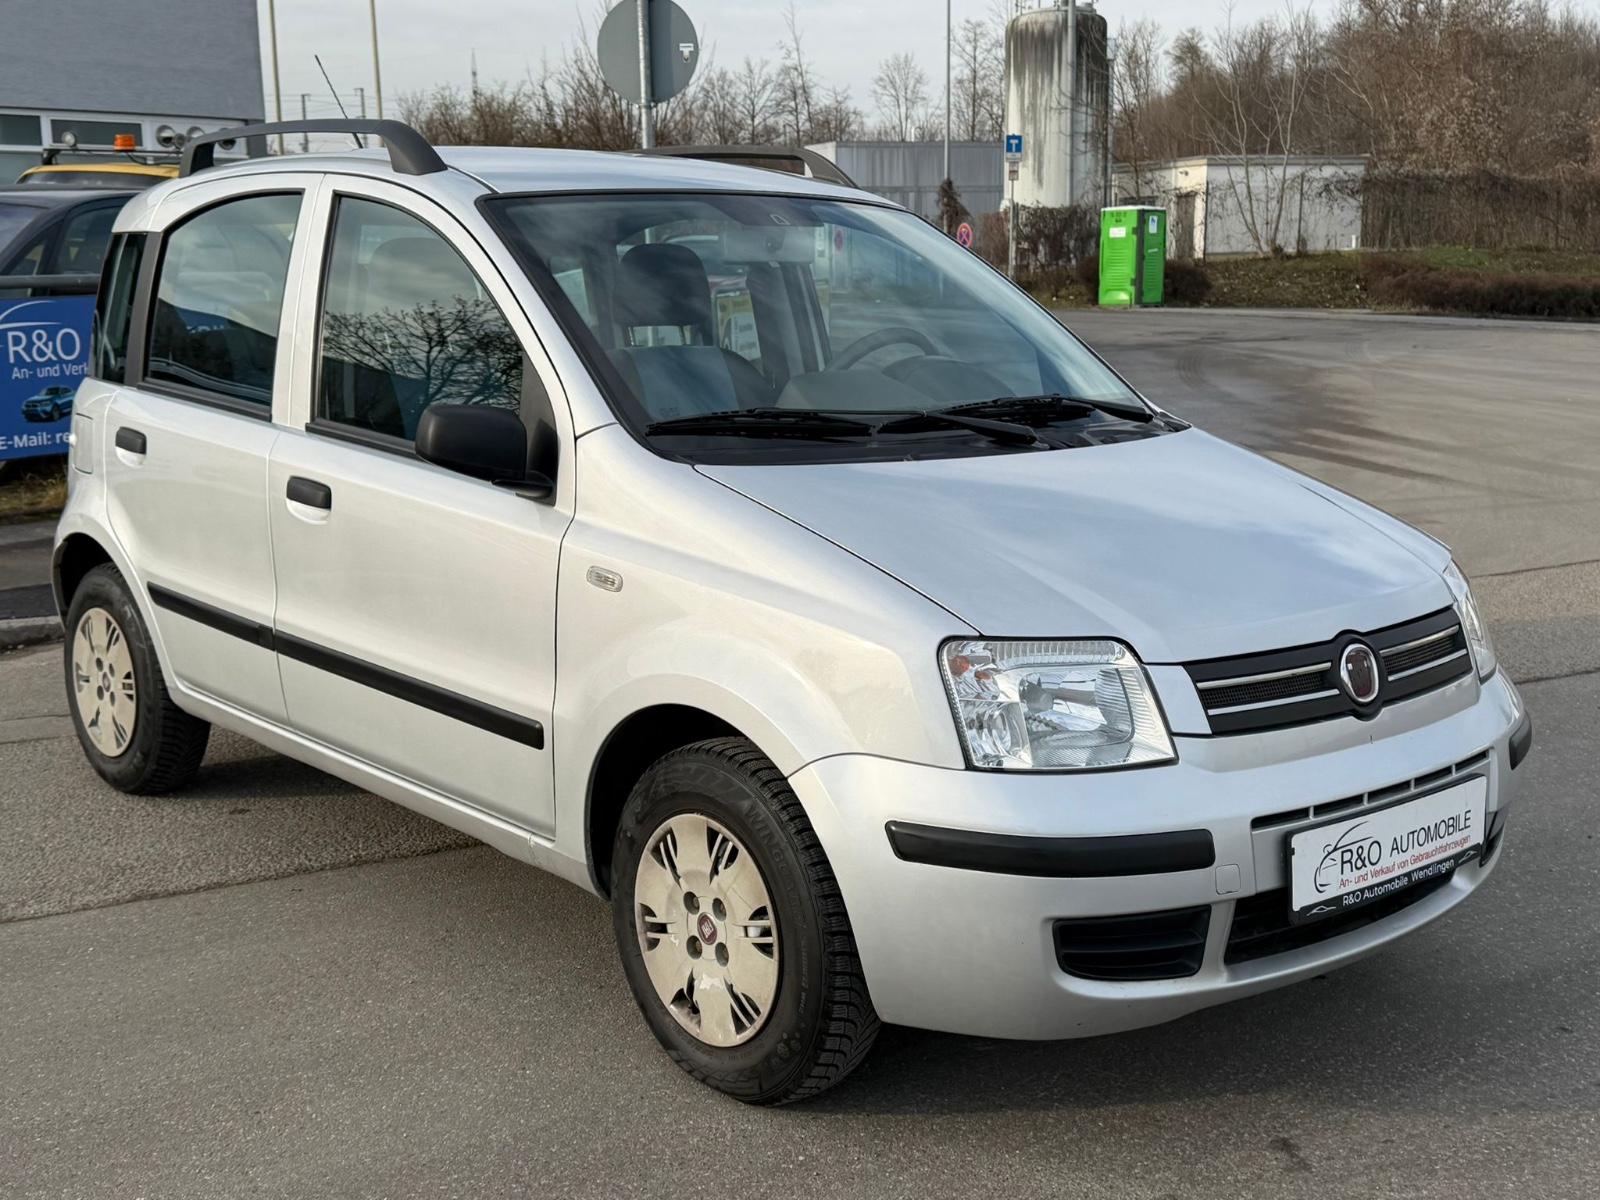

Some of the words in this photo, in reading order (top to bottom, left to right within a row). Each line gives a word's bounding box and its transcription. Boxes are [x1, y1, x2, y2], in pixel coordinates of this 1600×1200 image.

[7, 328, 81, 364] R&O
[12, 367, 33, 380] An-
[37, 364, 60, 377] und
[0, 432, 51, 450] E-Mail:
[1340, 840, 1382, 875] R&O
[1390, 810, 1471, 858] AUTOMOBILE
[1339, 878, 1353, 889] An-
[1354, 872, 1368, 884] und
[1370, 863, 1396, 880] Verkauf
[1397, 859, 1409, 870] von
[1342, 891, 1362, 906] R&O
[1363, 876, 1408, 900] Automobile
[1411, 859, 1455, 882] Wendlingen
